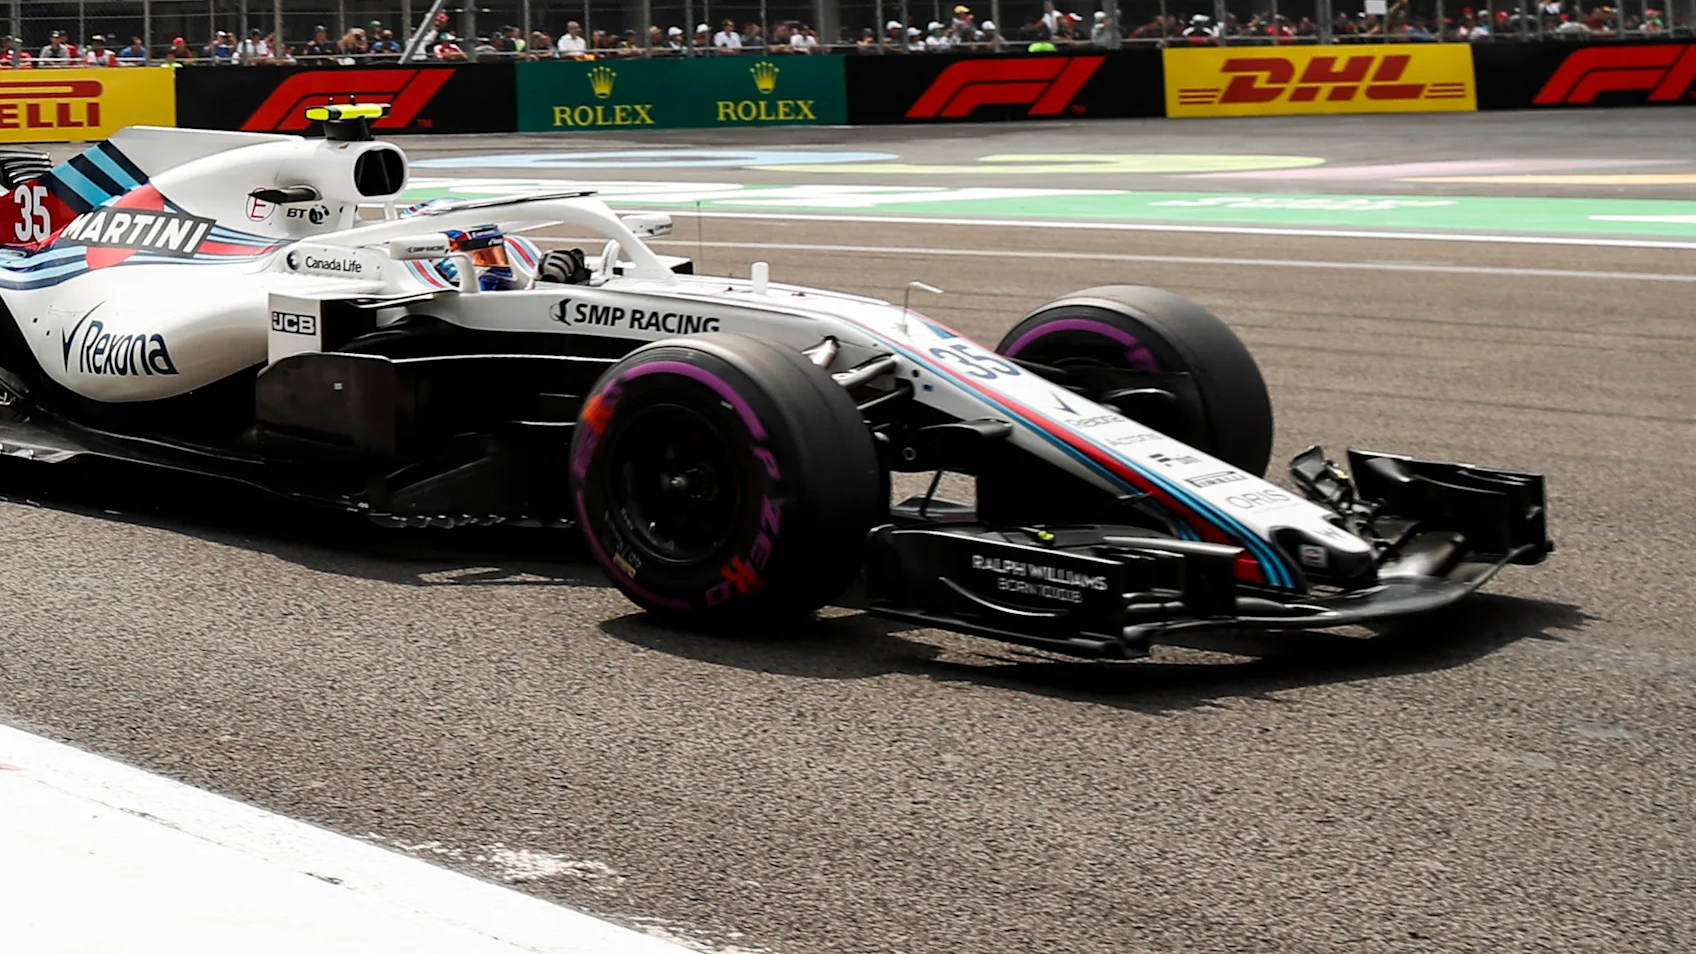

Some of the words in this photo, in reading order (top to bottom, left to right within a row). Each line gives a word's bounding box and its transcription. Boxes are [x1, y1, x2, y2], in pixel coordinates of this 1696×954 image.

[1217, 54, 1428, 104] DHL
[553, 105, 654, 128] ROLEX
[716, 99, 816, 122] ROLEX
[13, 184, 52, 242] 35
[286, 207, 308, 218] BT
[62, 211, 209, 255] MARTINI
[305, 256, 342, 272] Canada
[342, 260, 362, 273] Life
[273, 313, 316, 335] JCB
[573, 303, 626, 328] SMP
[628, 309, 721, 335] RACING
[79, 319, 180, 377] Rexona
[928, 344, 1021, 380] 35
[1184, 471, 1249, 488] PIRELLI
[1225, 490, 1291, 509] ORIS
[971, 554, 1027, 576] RALPH
[1027, 563, 1108, 591] WILLIAMS
